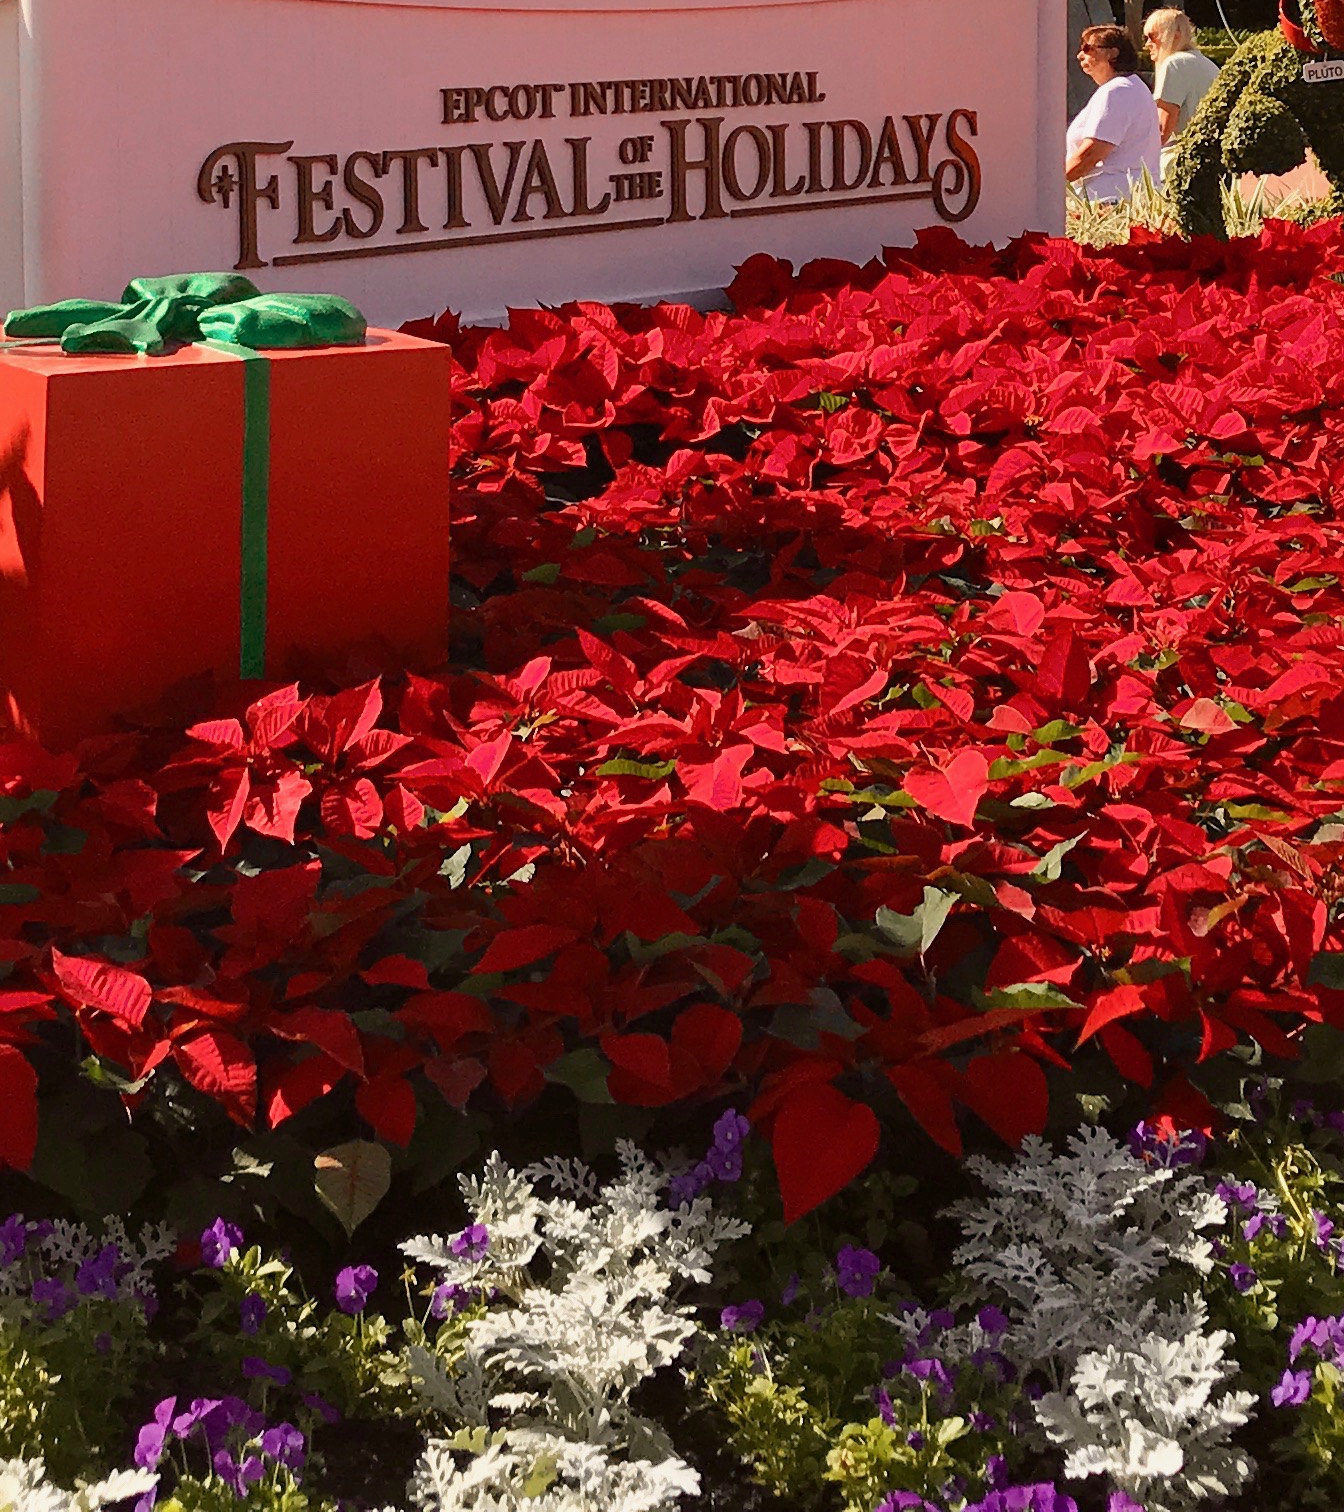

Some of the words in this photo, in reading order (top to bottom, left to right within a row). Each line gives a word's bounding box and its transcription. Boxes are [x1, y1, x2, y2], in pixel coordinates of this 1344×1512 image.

[1308, 66, 1343, 80] PLUTO
[439, 84, 562, 125] EPCOT
[568, 71, 826, 118] INTERNATIONAL
[618, 135, 654, 165] OF
[660, 108, 982, 223] HOLIDAYS
[197, 136, 611, 270] FESTIVAL
[609, 170, 663, 203] THE
